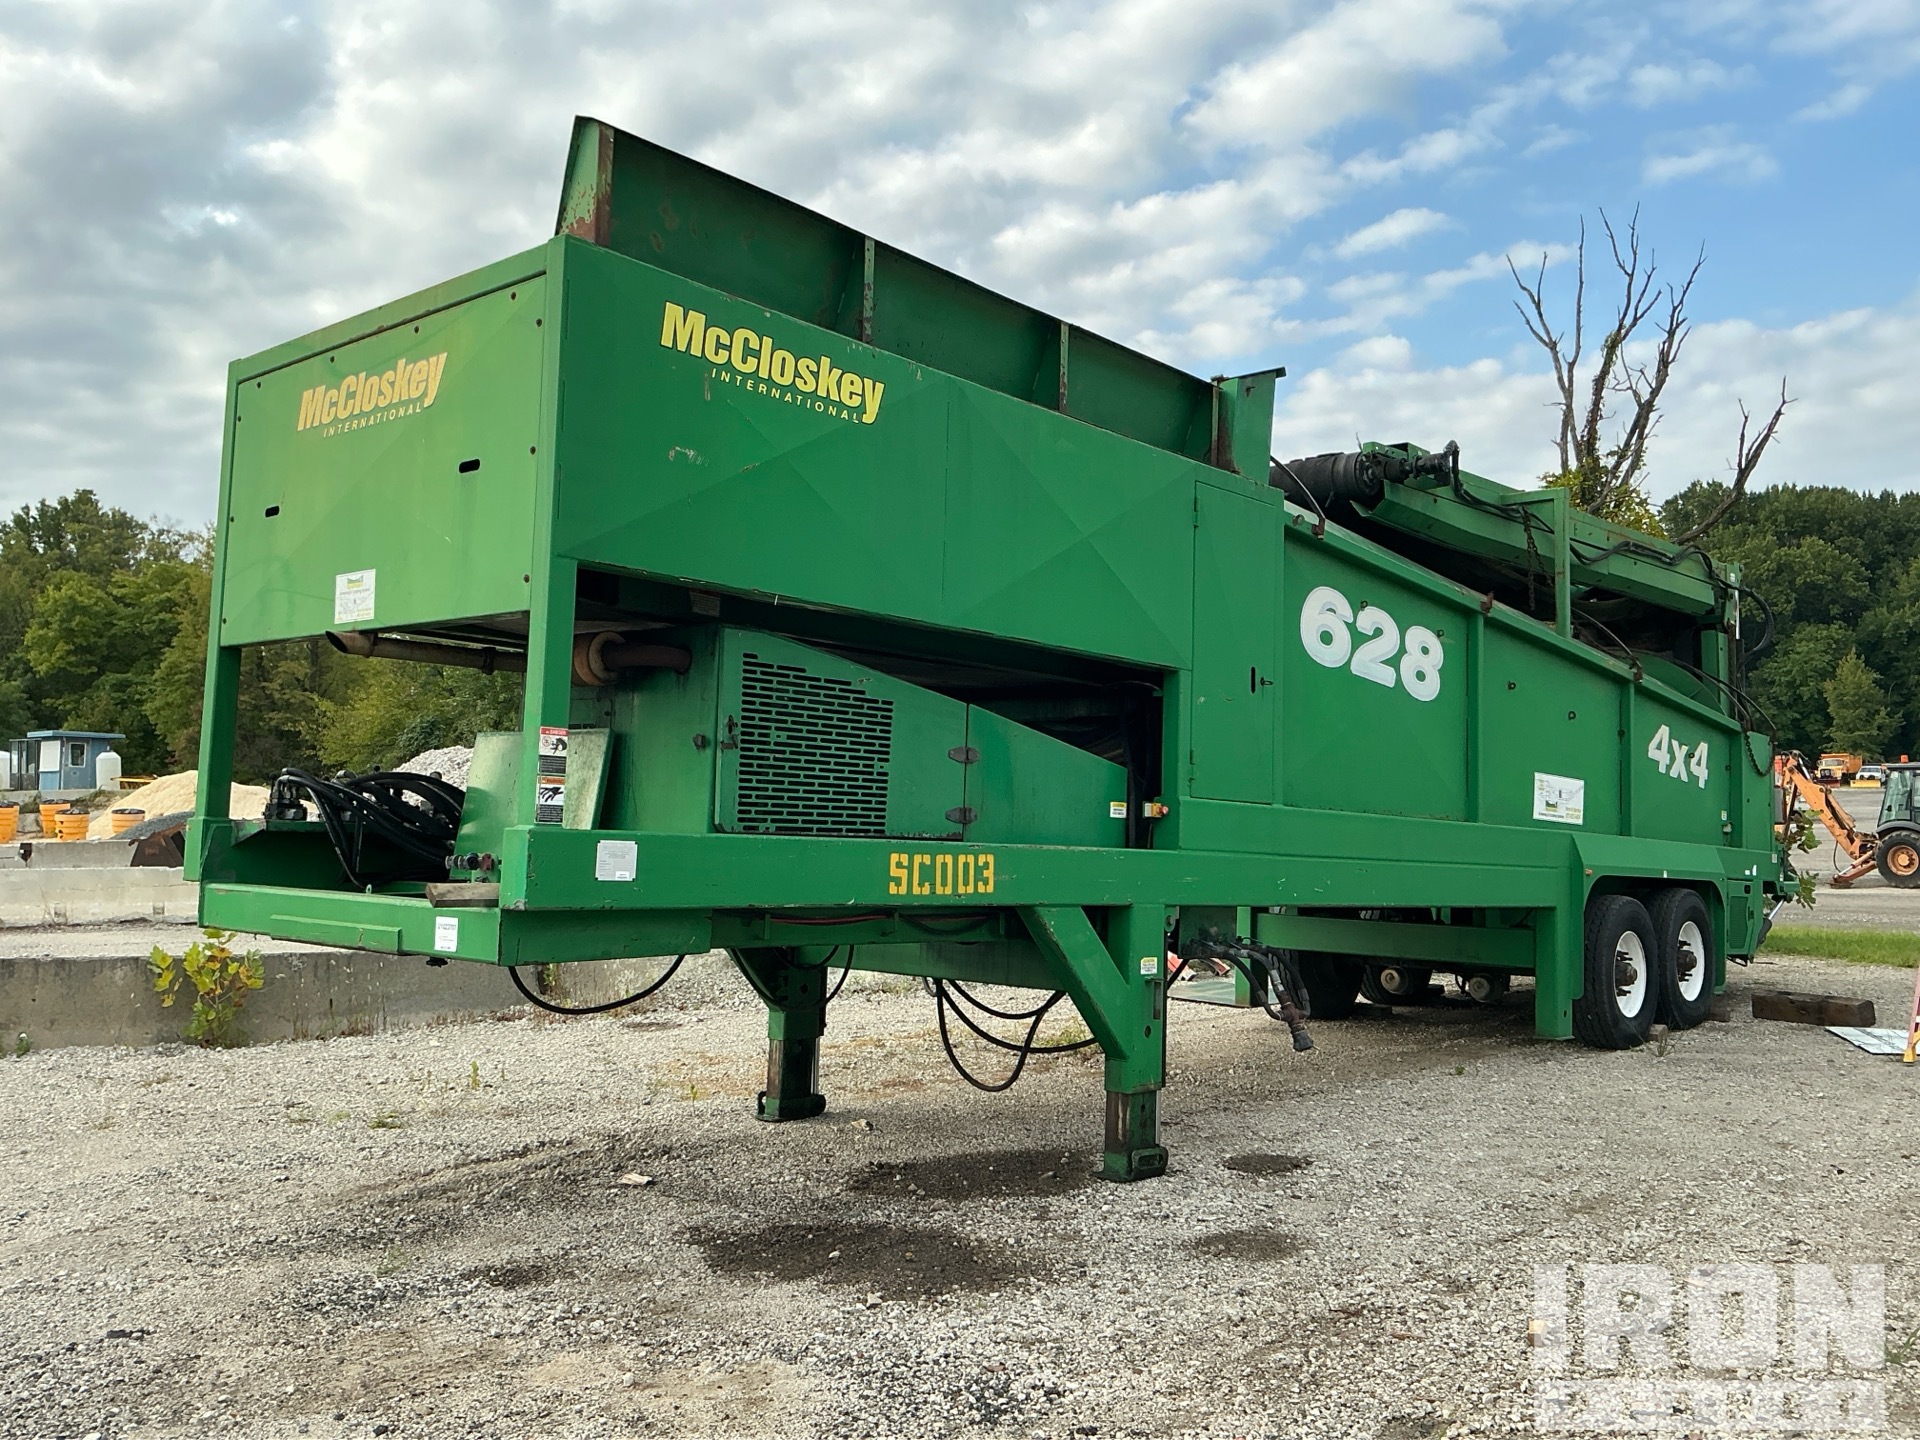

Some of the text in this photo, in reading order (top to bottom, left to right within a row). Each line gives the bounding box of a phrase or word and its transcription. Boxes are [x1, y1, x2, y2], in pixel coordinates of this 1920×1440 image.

[297, 352, 448, 432] McCloskey
[661, 302, 885, 424] McCloskey
[711, 367, 860, 424] INTERNATIONAL
[323, 402, 422, 438] INTERNATIONAL
[1300, 586, 1444, 702] 628
[1648, 724, 1708, 789] 4x4
[889, 853, 994, 895] SC003
